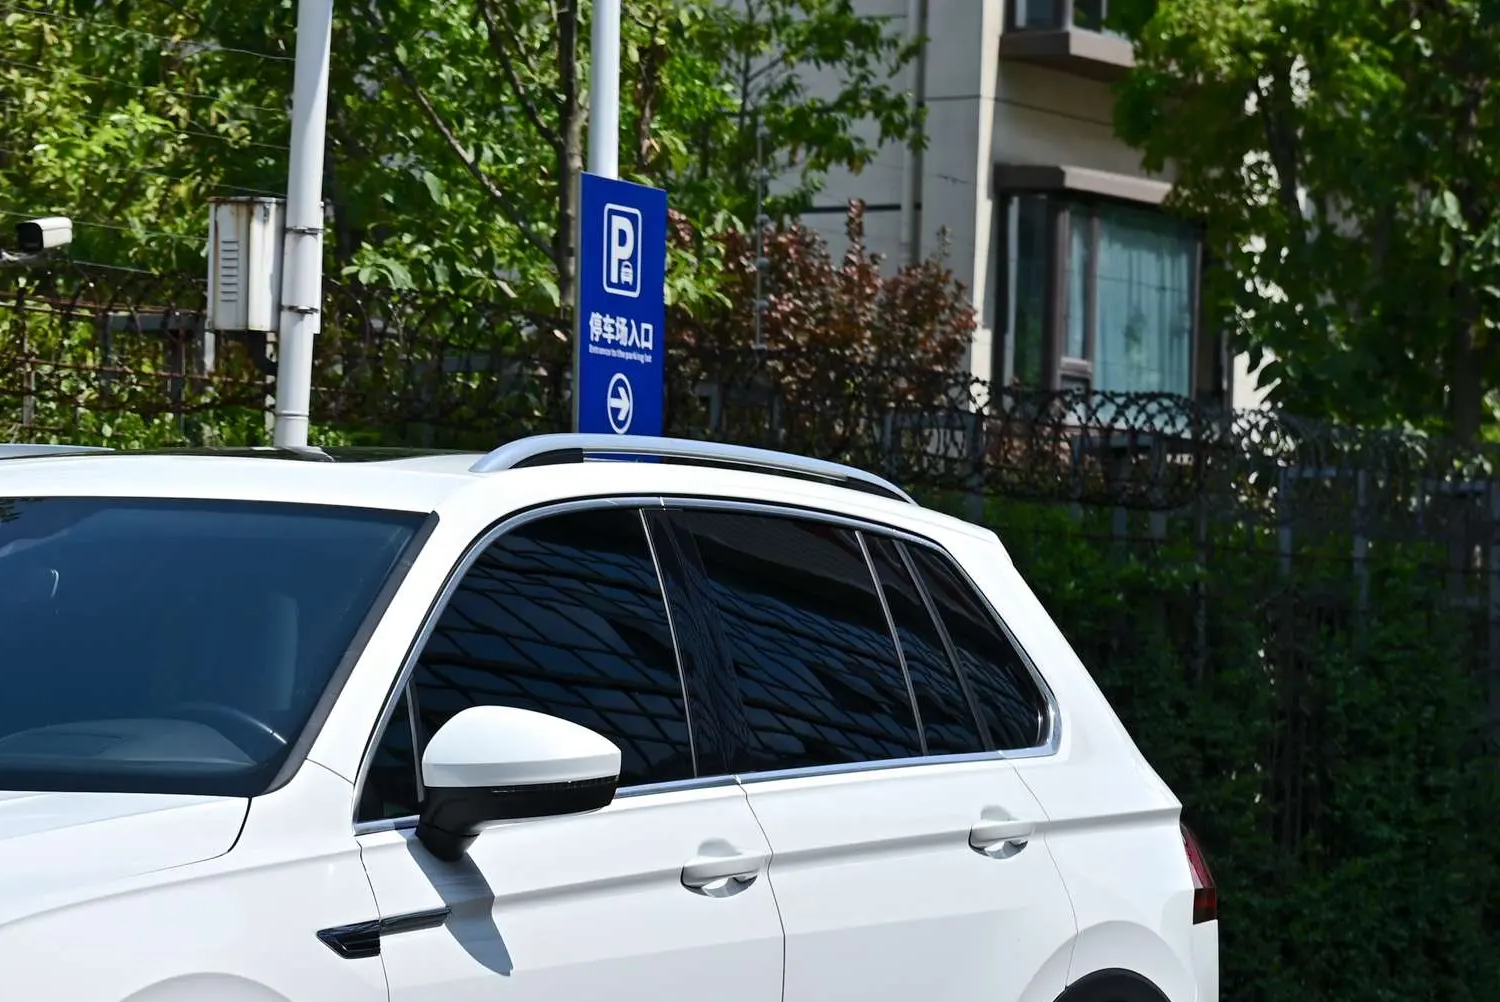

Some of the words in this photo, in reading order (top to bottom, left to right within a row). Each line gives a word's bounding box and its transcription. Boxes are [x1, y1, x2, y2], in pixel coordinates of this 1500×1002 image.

[611, 215, 634, 283] P
[589, 312, 653, 350] 停车场入口
